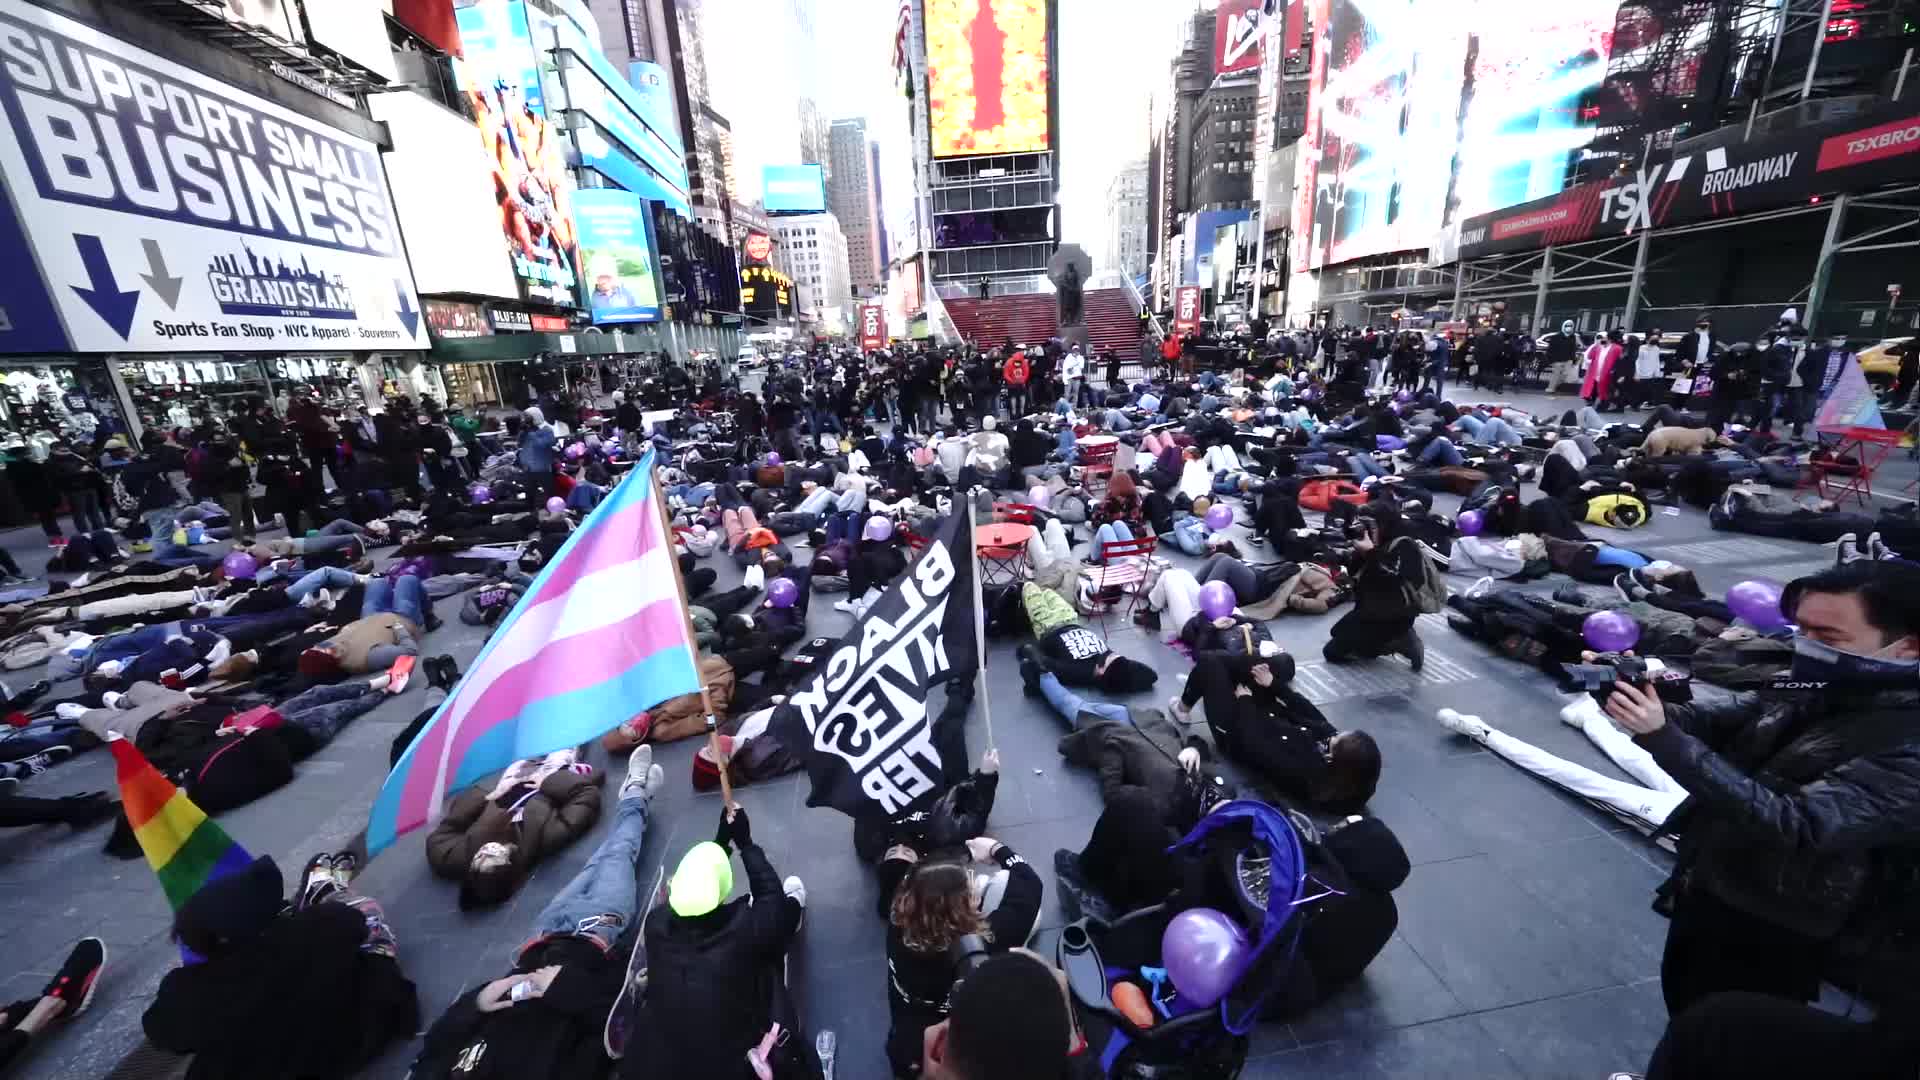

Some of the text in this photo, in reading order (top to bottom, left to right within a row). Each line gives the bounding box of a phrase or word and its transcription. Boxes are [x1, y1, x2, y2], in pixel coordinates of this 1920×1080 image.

[0, 21, 257, 155] SUPPORT
[261, 118, 379, 193] SMALL
[15, 87, 394, 257] BUSINESS
[1599, 163, 1663, 230] TSX
[1701, 152, 1798, 196] BROADWAY
[153, 320, 400, 340] Sports Fan Shop NYC Apparel Souvenirs
